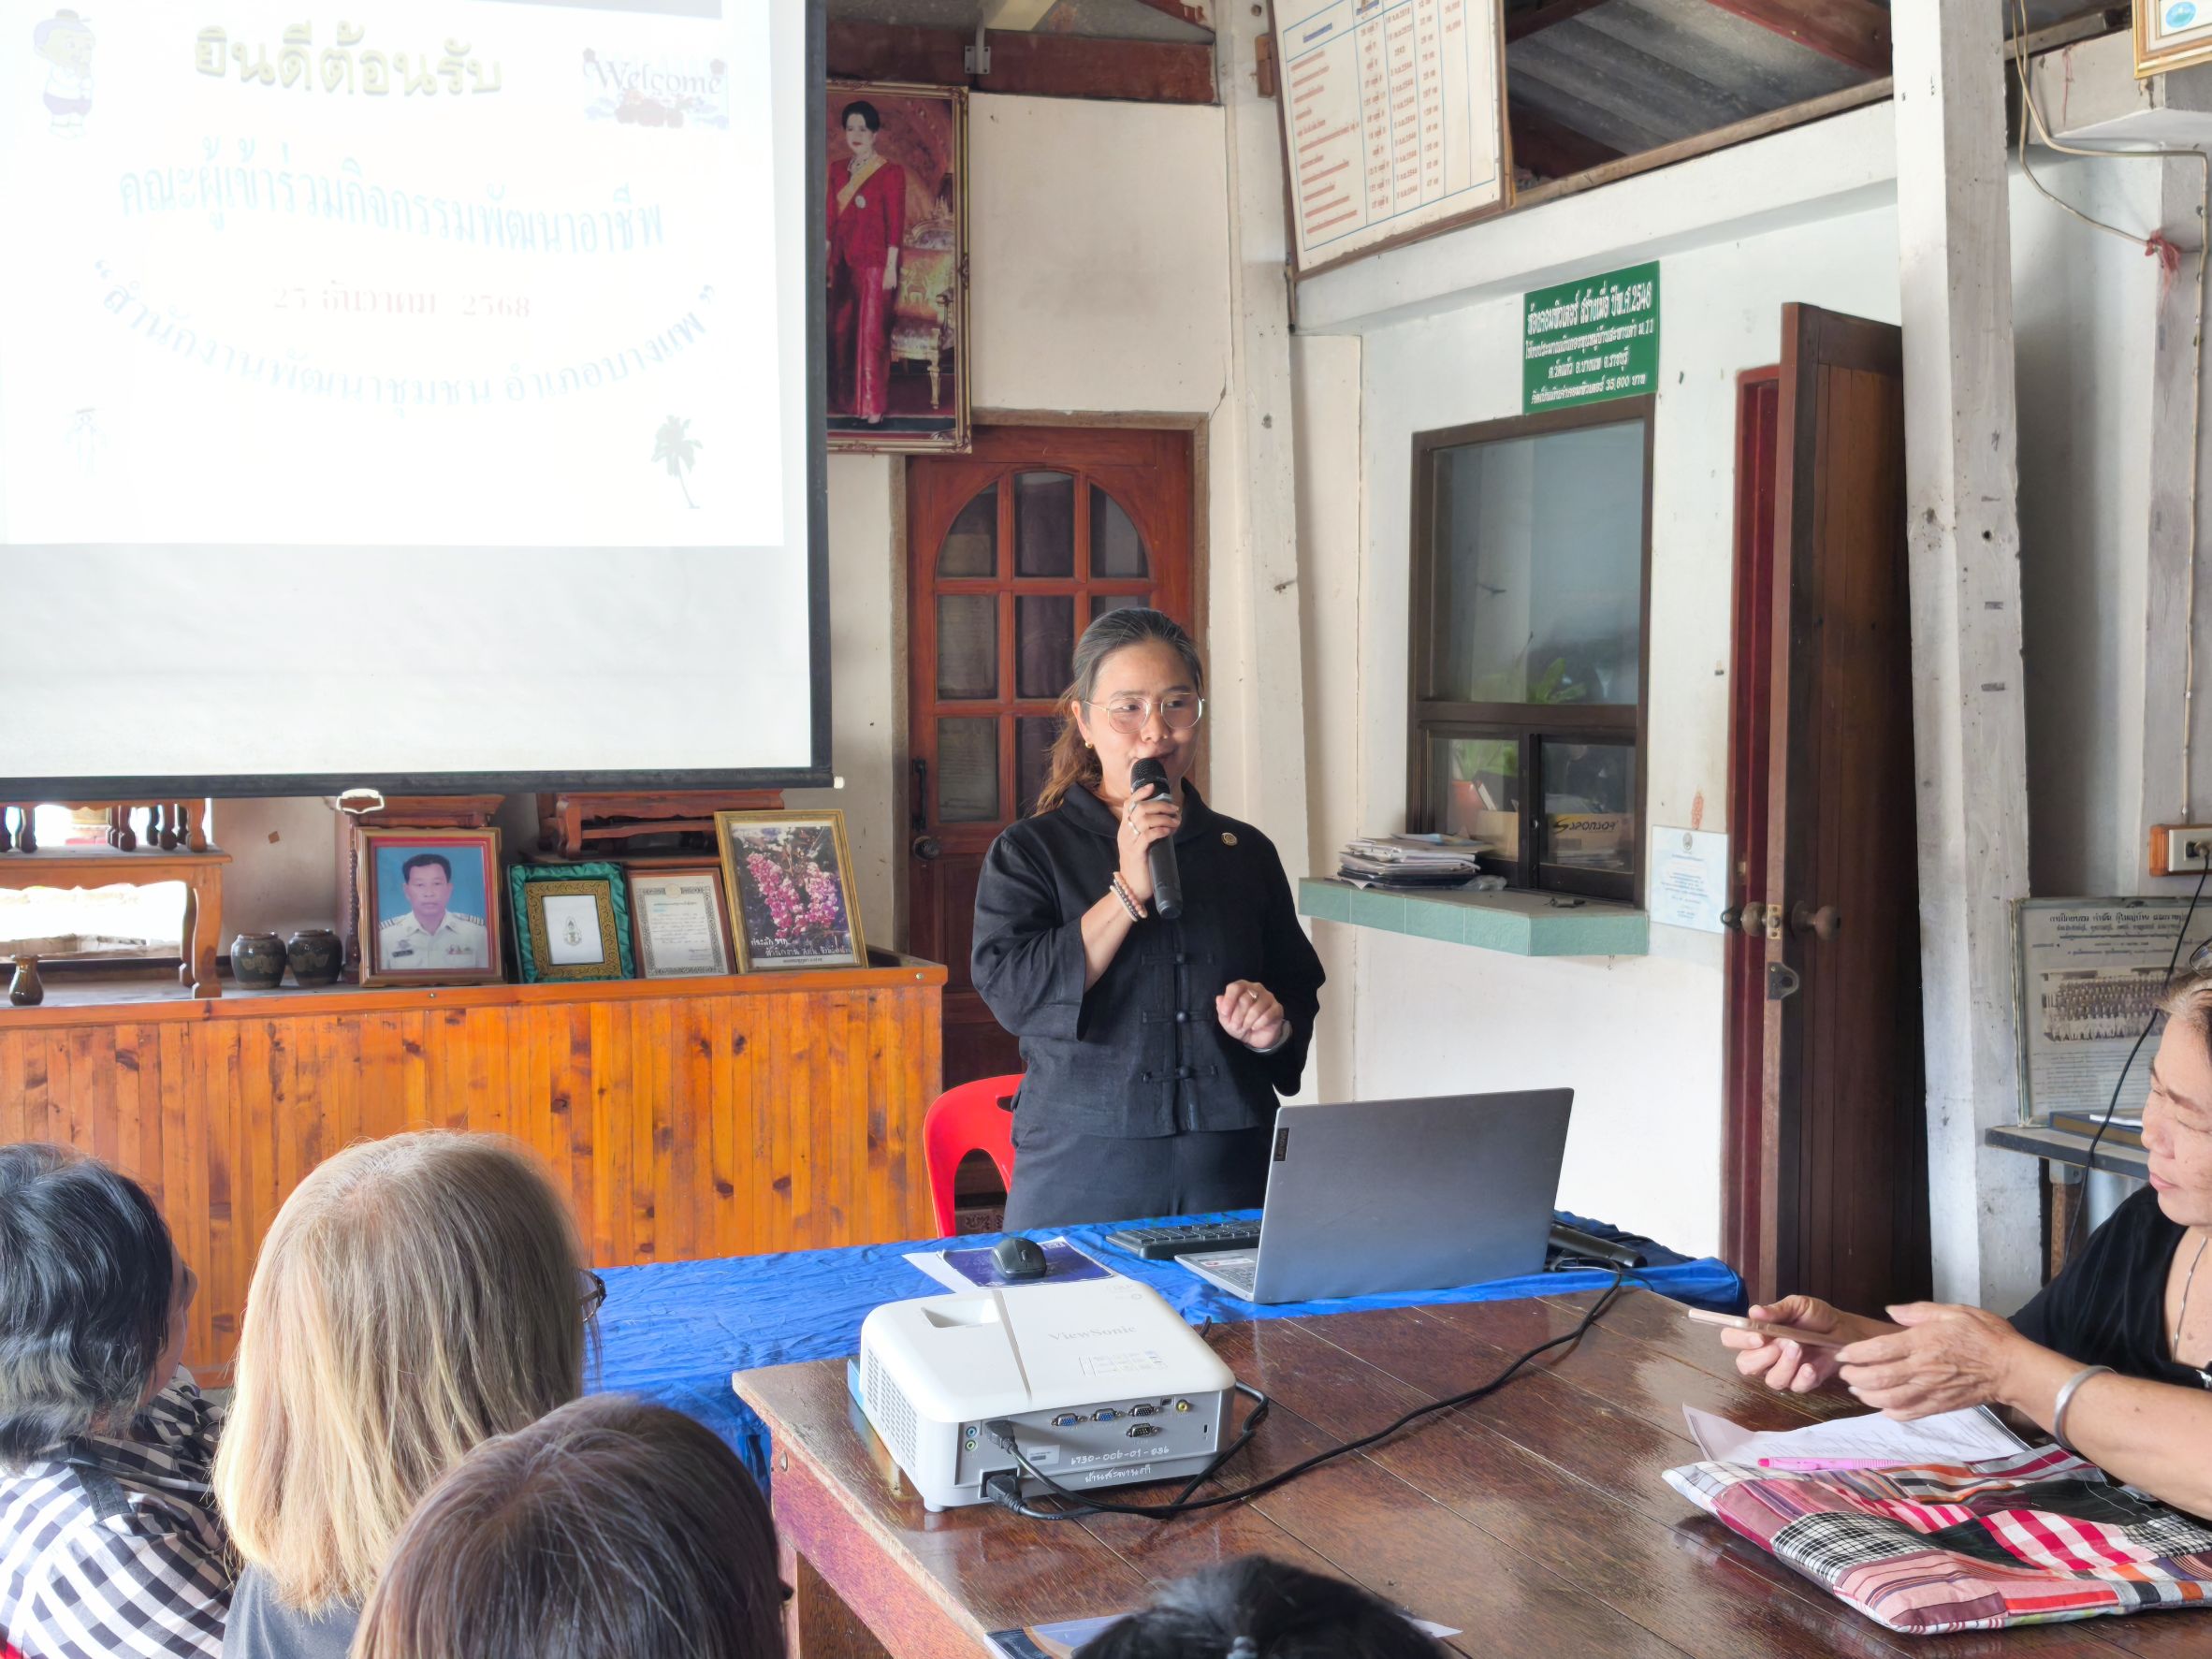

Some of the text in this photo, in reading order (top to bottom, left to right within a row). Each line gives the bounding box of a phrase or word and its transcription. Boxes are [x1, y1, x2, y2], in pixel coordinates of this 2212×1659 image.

[195, 19, 502, 97] ยินดีต้อนรับ
[585, 58, 721, 95] Welcome
[120, 135, 665, 255] คณะผู้เข้าร่วมกิจกรรมพัฒนาอาชีพ
[272, 279, 531, 319] 25 ธันวาคม 2568
[1048, 1325, 1138, 1341] ViewSonic
